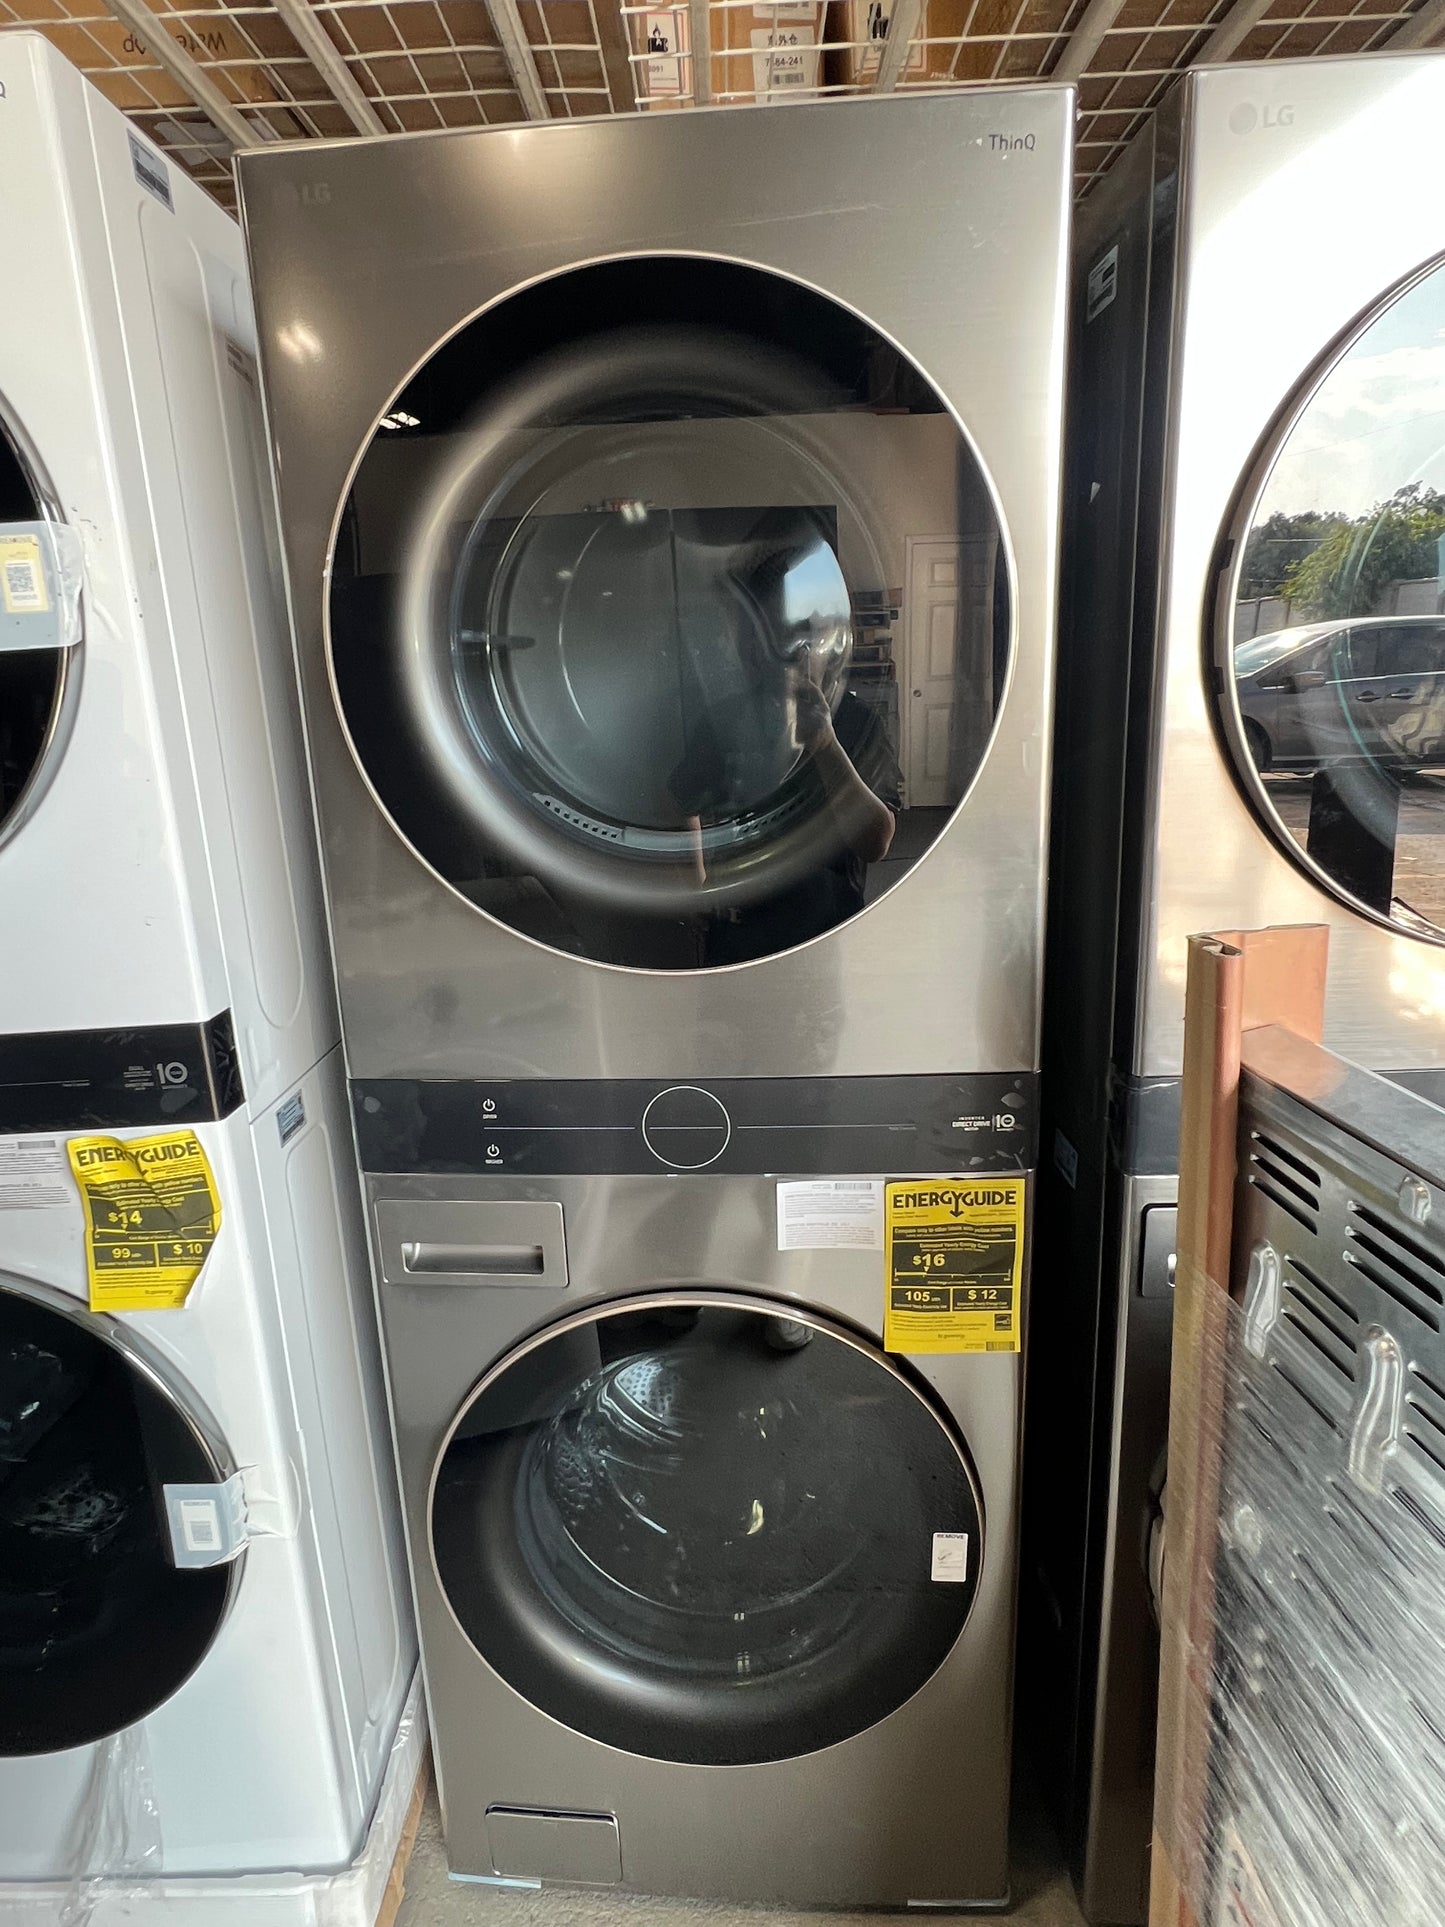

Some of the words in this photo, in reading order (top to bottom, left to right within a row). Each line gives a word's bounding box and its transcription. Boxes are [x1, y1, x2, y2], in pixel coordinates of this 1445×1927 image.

[1263, 104, 1295, 128] LG
[988, 133, 1036, 152] ThinQ
[892, 1190, 1017, 1210] ENERGYGUIDE
[108, 1210, 143, 1225] $14
[112, 1248, 131, 1259] 99
[173, 1244, 183, 1255] $
[186, 1243, 203, 1254] 10
[912, 1253, 946, 1267] $16
[905, 1290, 931, 1302] 105
[968, 1289, 977, 1300] $
[981, 1289, 998, 1300] 12
